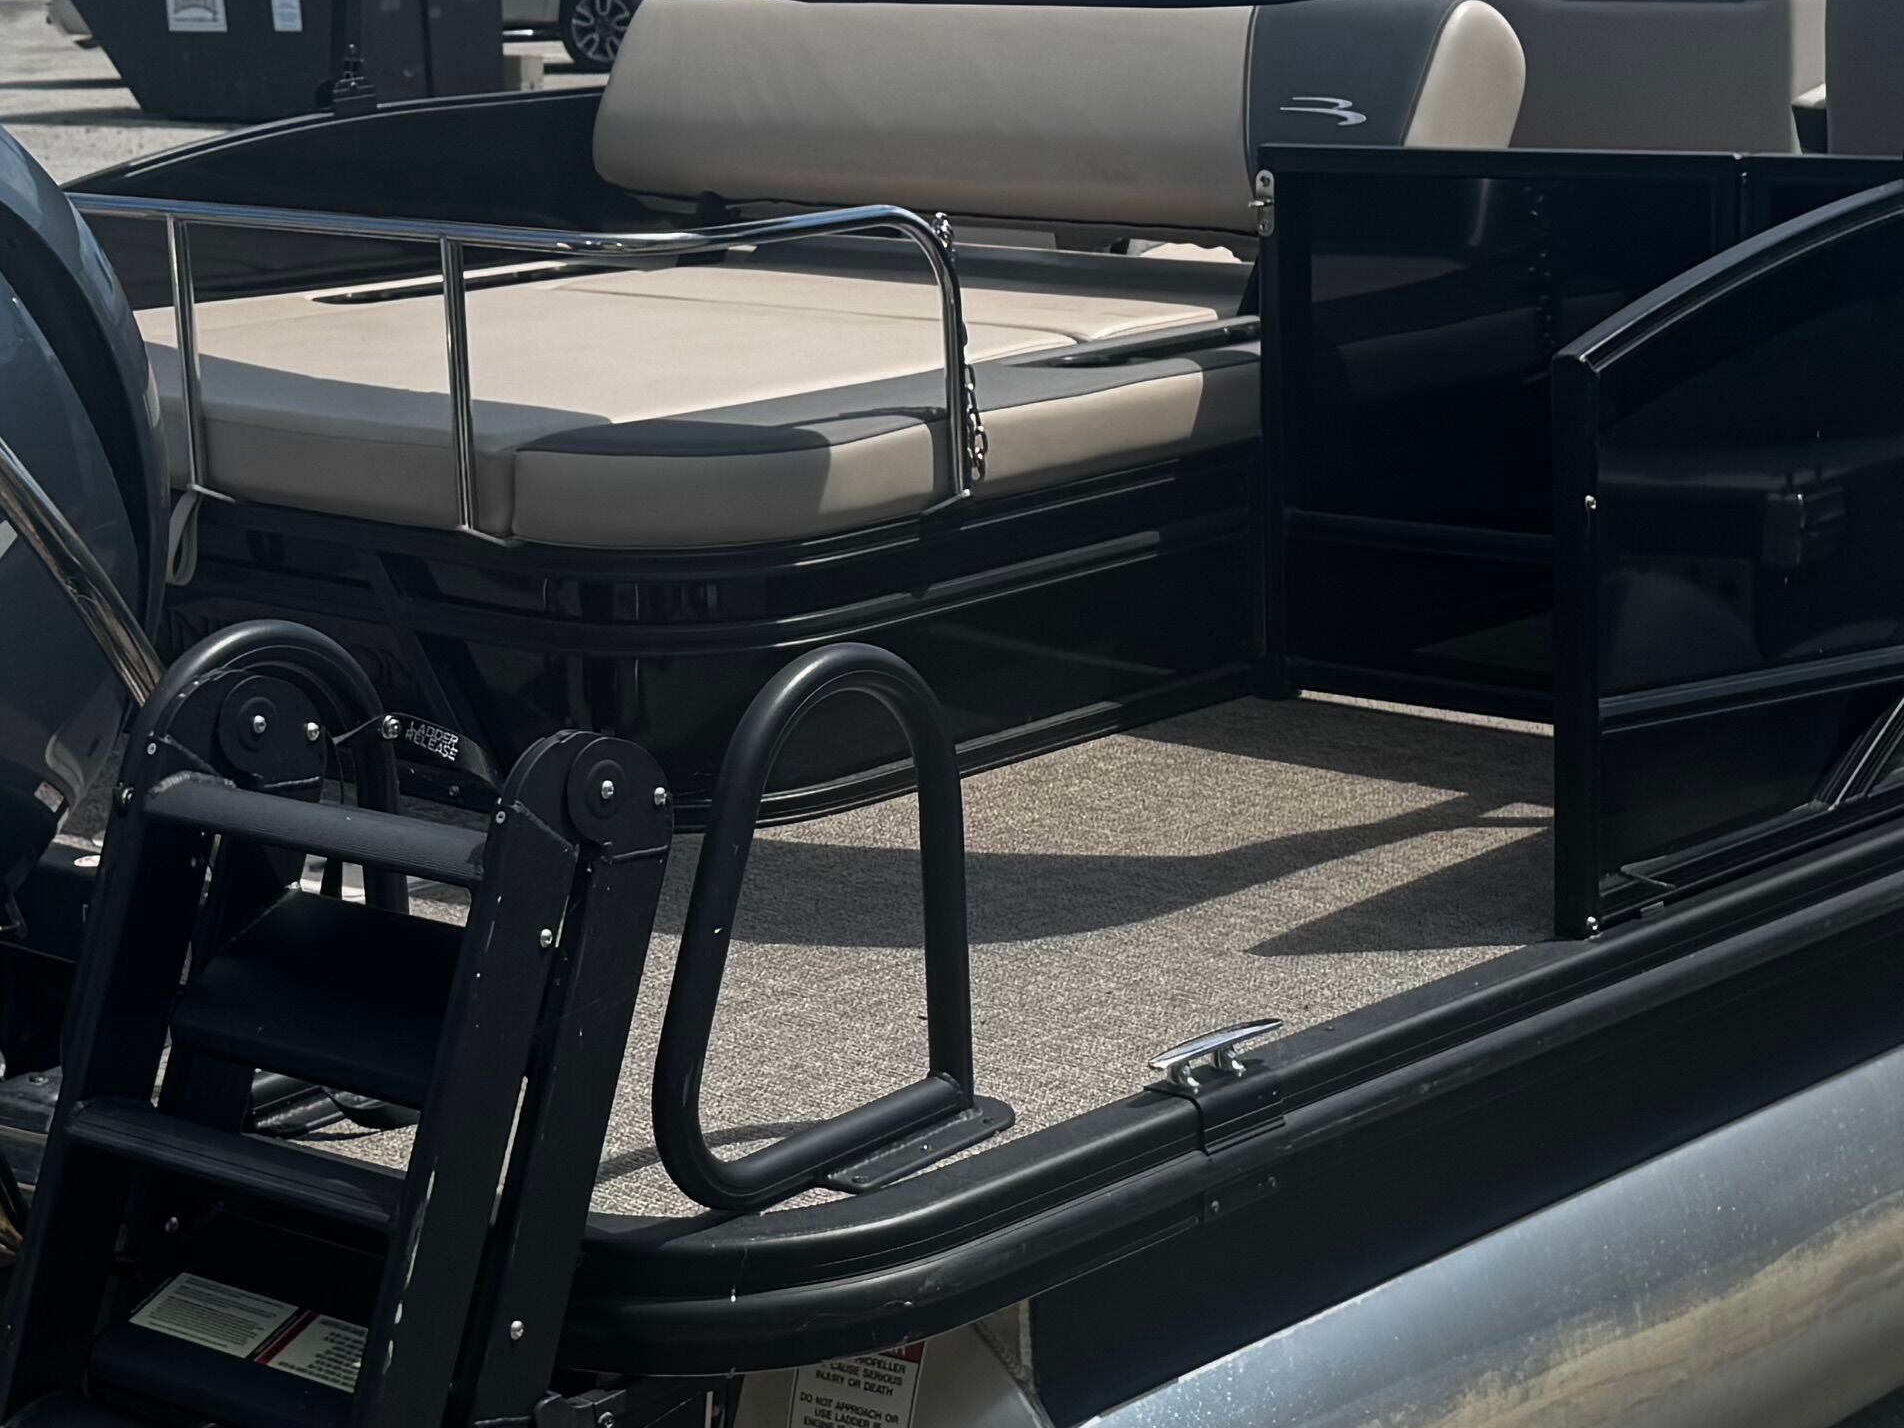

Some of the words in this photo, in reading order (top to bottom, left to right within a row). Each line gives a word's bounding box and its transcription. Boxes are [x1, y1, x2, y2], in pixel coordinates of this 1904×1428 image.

[405, 729, 459, 762] RELEASE
[409, 720, 459, 745] LADDER
[815, 1369, 844, 1384] INJURY
[848, 1378, 861, 1388] OR
[863, 1381, 894, 1397] DEATH
[863, 1368, 903, 1386] SERIOUS
[800, 1391, 813, 1403] DO
[815, 1396, 833, 1408] NOT
[835, 1401, 882, 1420] APPROACH
[885, 1413, 899, 1424] OR
[814, 1408, 832, 1419] USE
